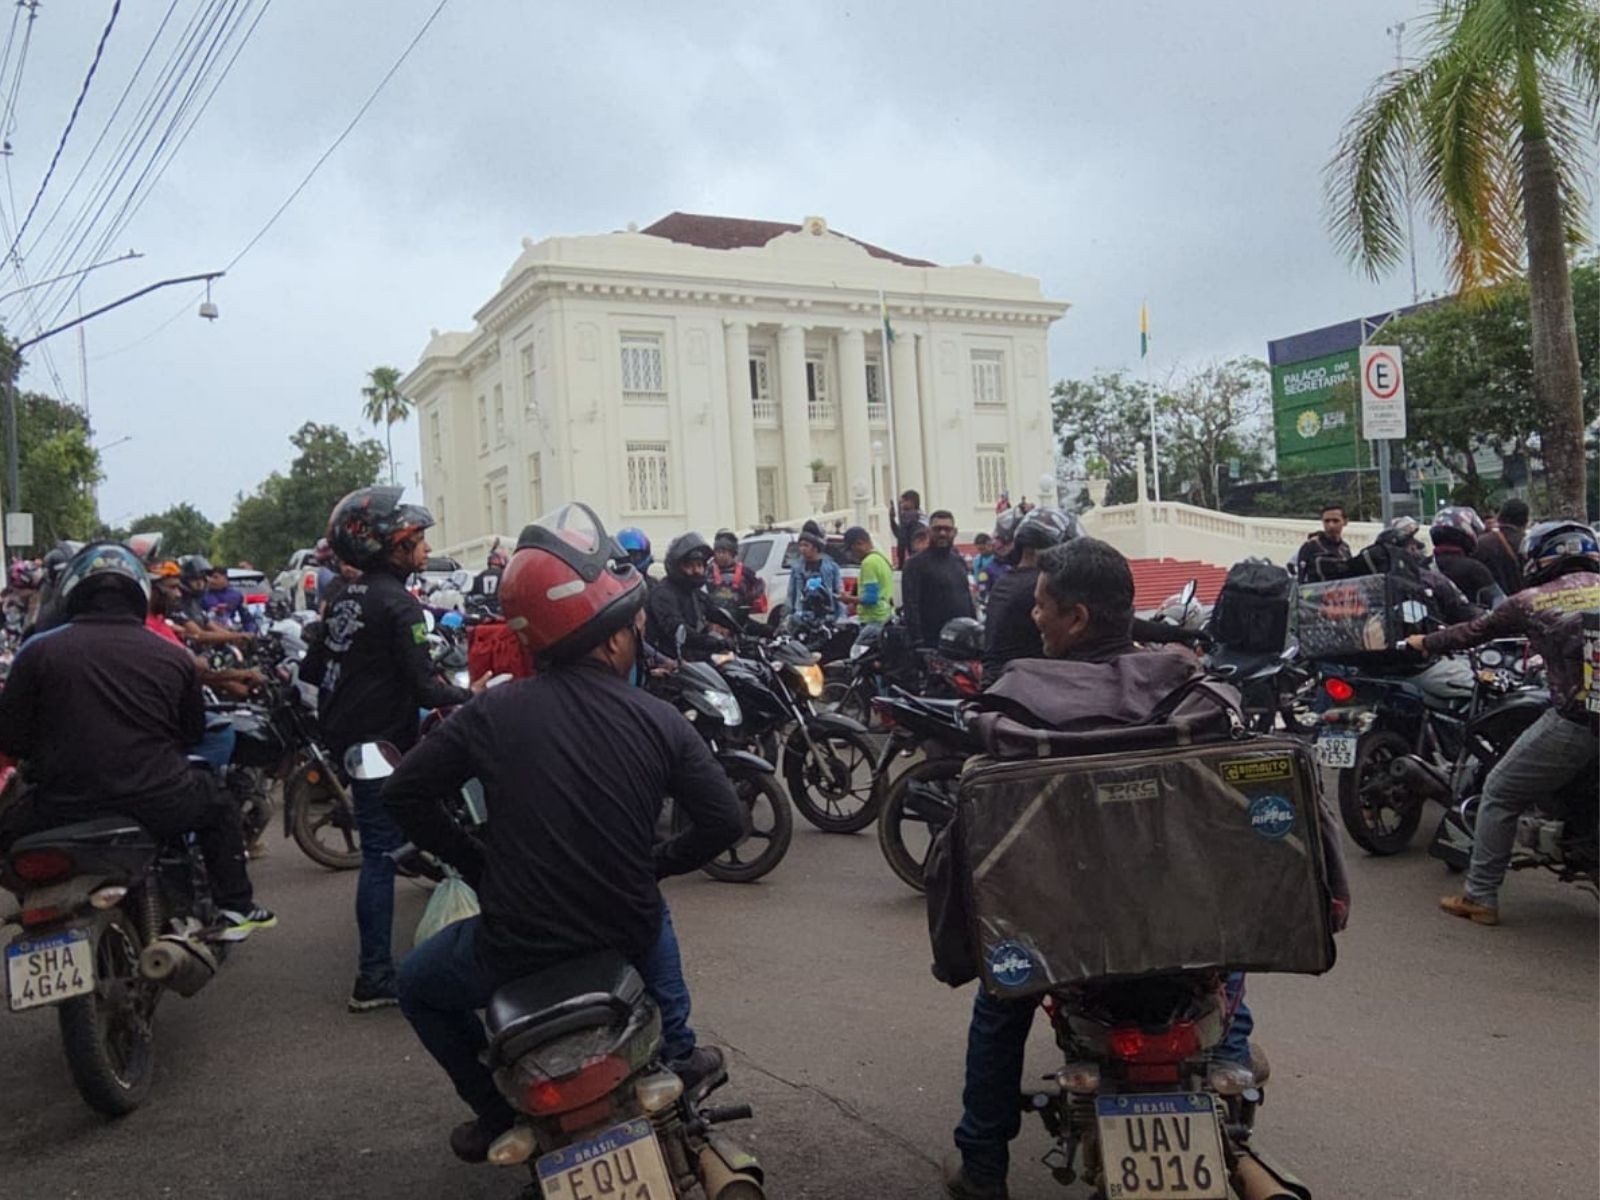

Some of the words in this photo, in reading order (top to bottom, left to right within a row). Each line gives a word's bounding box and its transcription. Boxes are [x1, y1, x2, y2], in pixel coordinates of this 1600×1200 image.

[1376, 364, 1390, 389] E
[29, 947, 74, 976] SHA
[23, 967, 84, 1000] 4G44
[1134, 1101, 1177, 1113] BRASIL
[1126, 1117, 1191, 1152] UAV
[574, 1139, 618, 1163] BRASIL
[568, 1149, 639, 1200] EQU
[1121, 1154, 1212, 1191] 8J16
